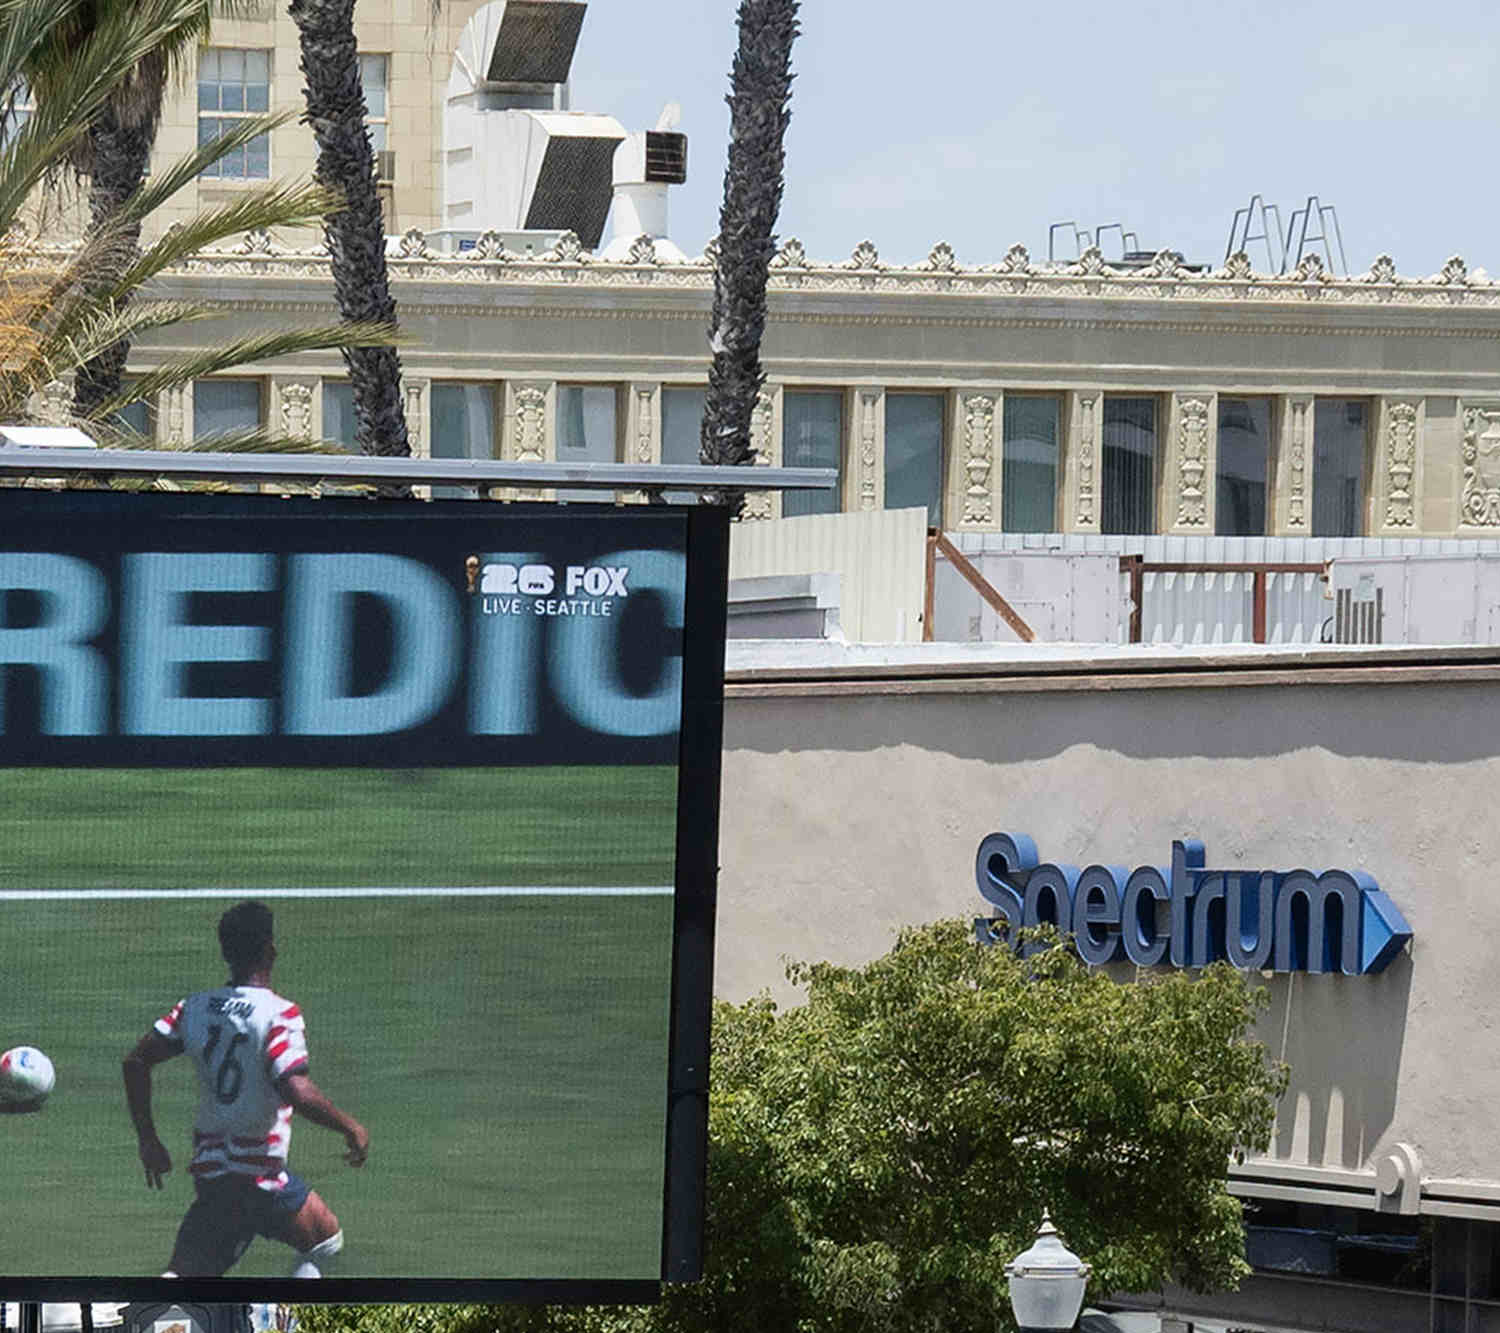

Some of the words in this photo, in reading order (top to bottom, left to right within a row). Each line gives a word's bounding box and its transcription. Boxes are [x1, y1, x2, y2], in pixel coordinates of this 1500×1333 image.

[565, 565, 631, 597] FOX
[483, 599, 521, 616] LIVE
[534, 600, 613, 618] SEATTLE
